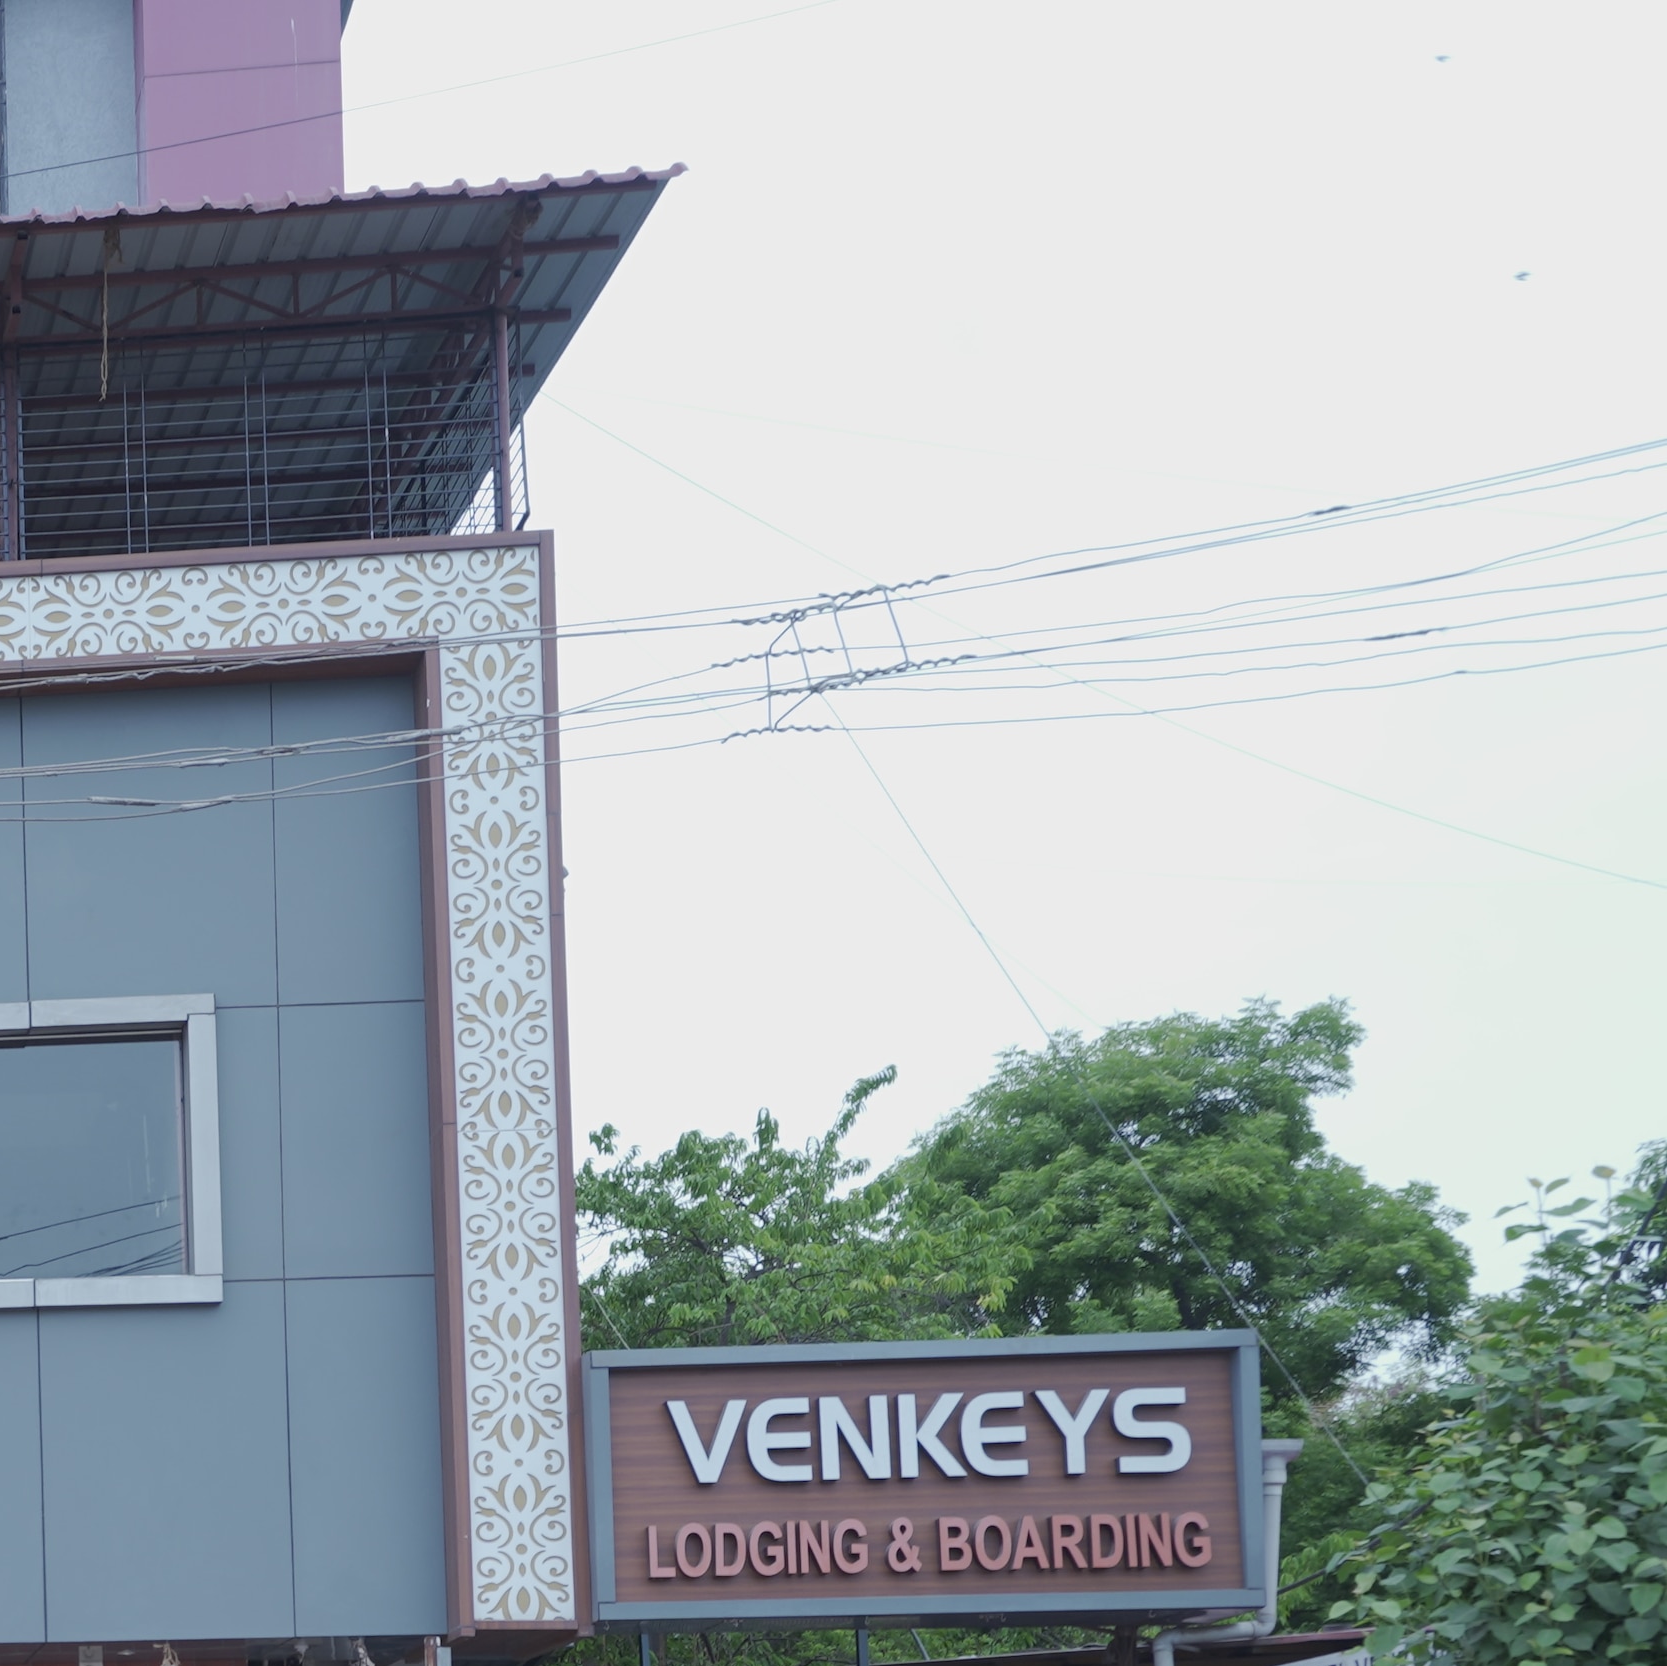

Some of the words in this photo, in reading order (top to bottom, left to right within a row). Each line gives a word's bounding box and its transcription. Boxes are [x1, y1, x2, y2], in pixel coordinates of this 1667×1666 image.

[665, 1386, 1193, 1485] VENKEYS
[646, 1517, 869, 1580] LODGING
[886, 1515, 923, 1574] &
[937, 1510, 1213, 1572] BOARDING
